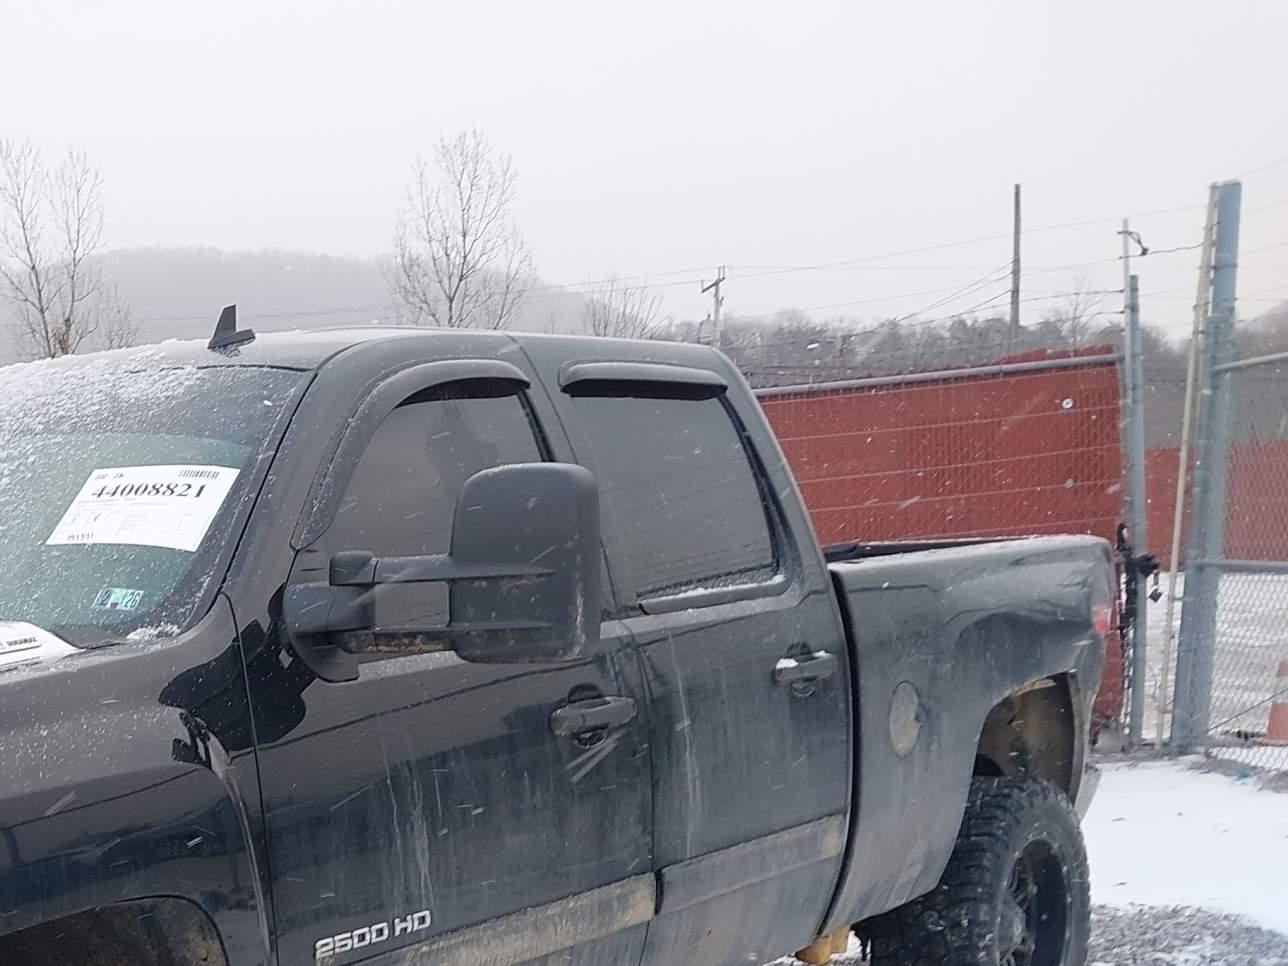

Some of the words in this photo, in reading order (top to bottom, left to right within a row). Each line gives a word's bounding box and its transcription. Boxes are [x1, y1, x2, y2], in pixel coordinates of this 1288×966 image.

[91, 482, 206, 498] 44008821
[124, 592, 140, 608] 26
[315, 922, 389, 959] 2500
[394, 910, 431, 936] HD
